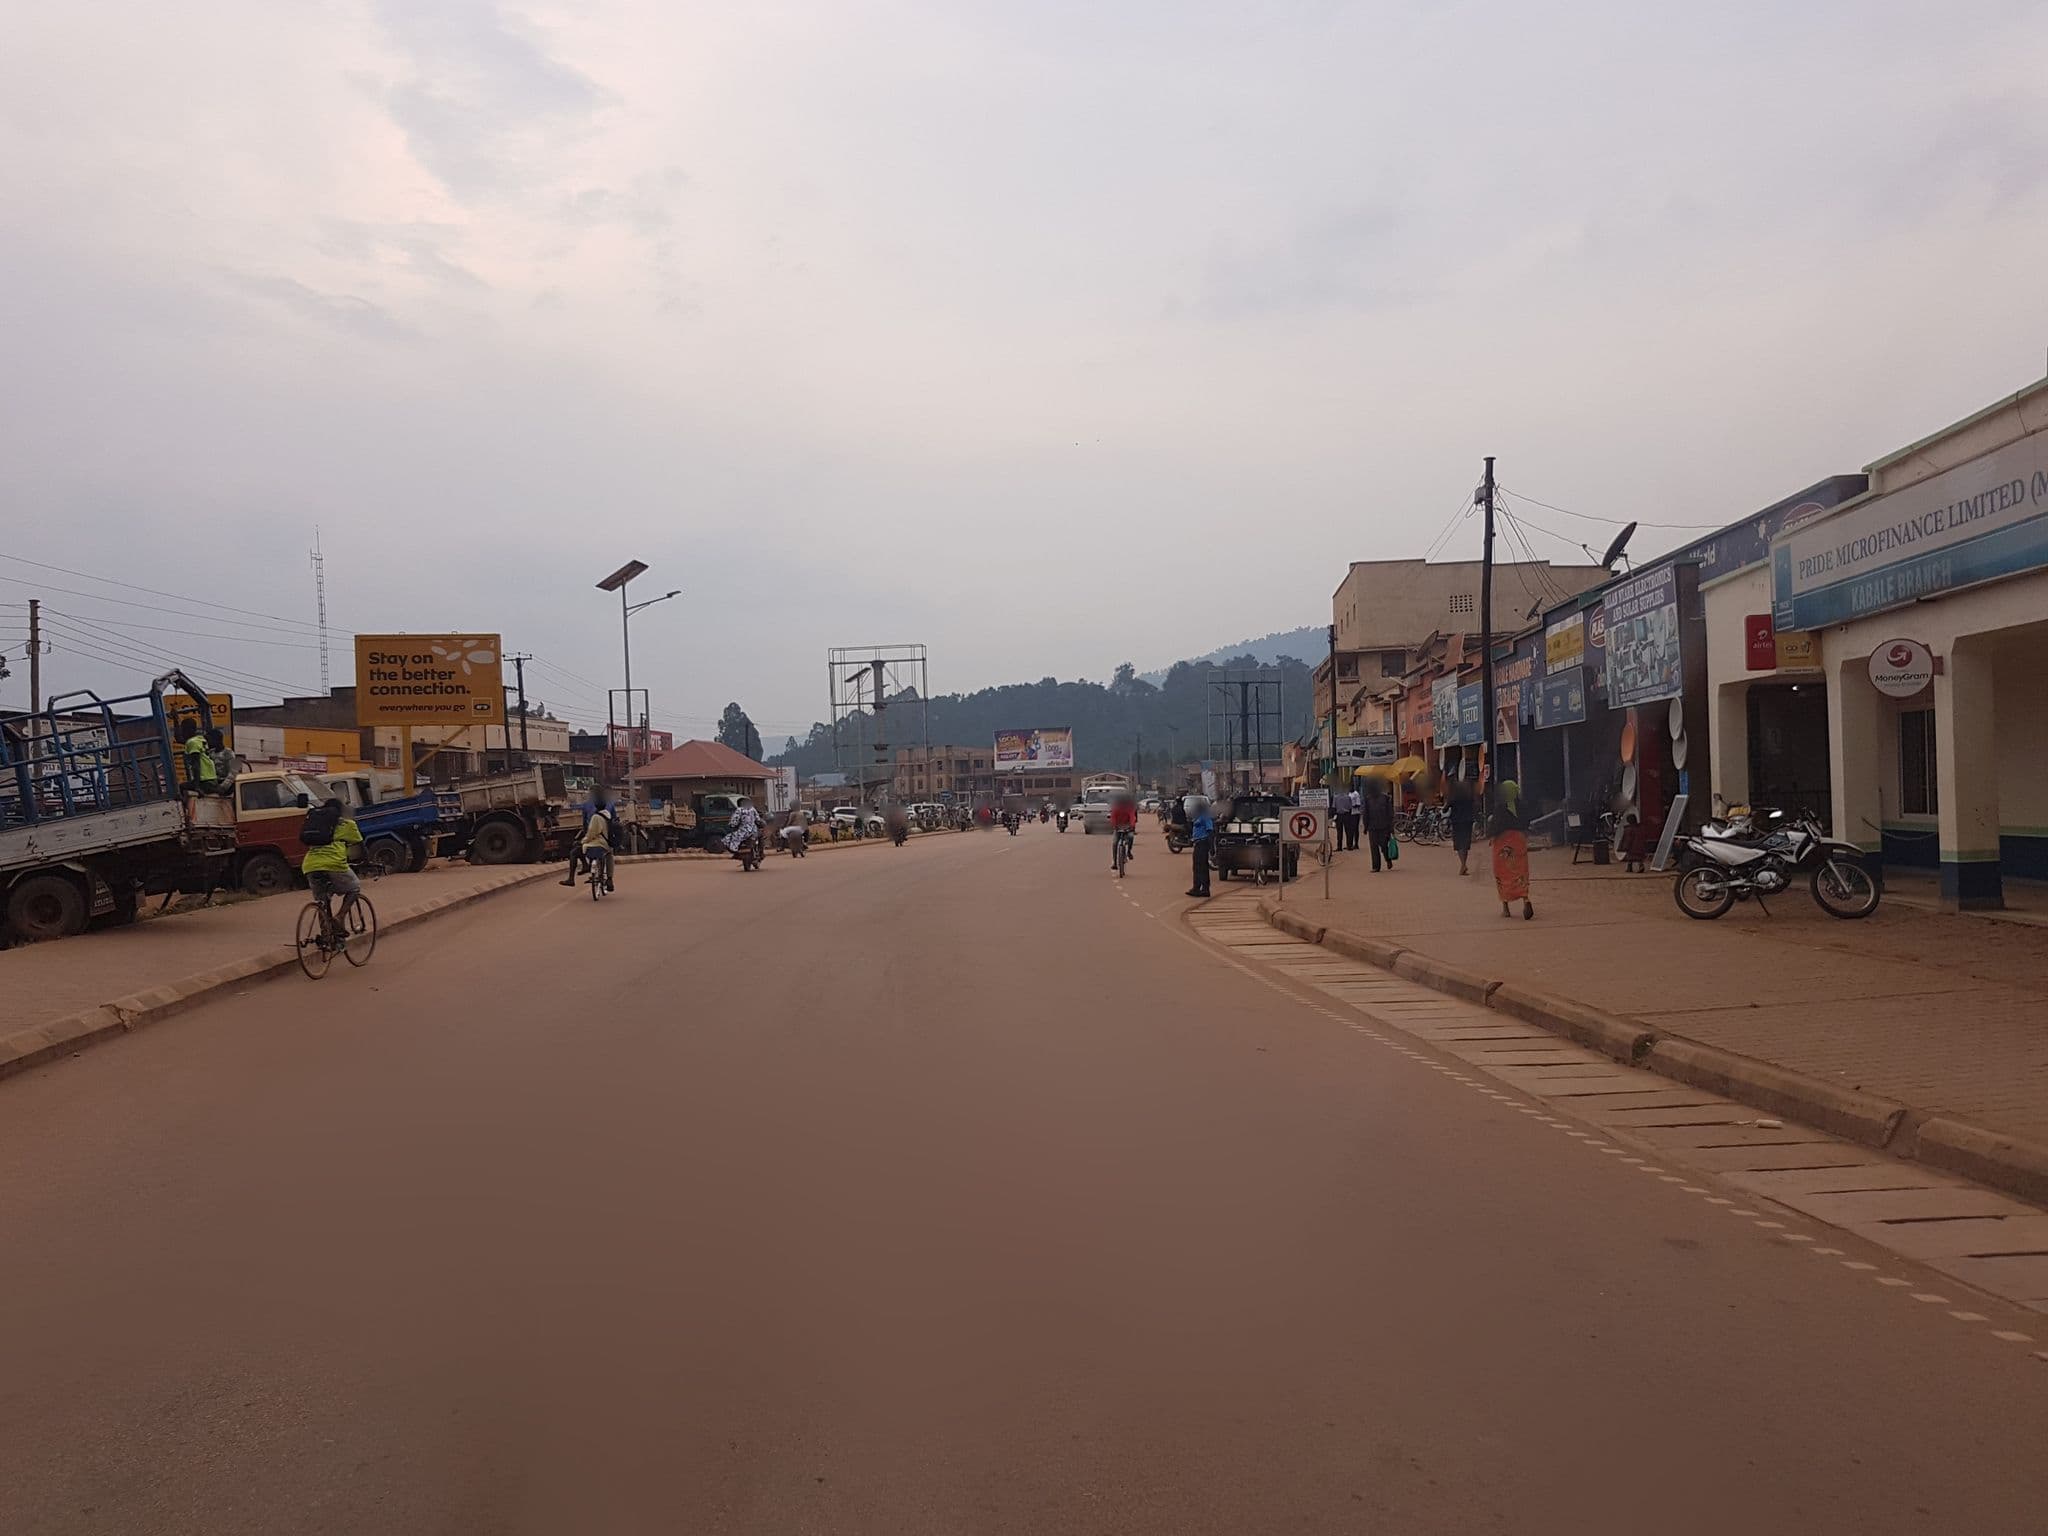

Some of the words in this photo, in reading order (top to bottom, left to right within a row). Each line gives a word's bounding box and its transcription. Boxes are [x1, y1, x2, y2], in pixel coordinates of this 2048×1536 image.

[1799, 551, 1833, 579] PRIDE
[1836, 509, 1944, 567] MICROFINANCE
[1948, 479, 2025, 528] LIMITED
[1852, 576, 1894, 611] KABALE
[1896, 559, 1951, 595] BRANCH
[1753, 641, 1773, 649] airtel
[369, 652, 407, 667] Stay
[412, 654, 433, 664] on
[369, 668, 397, 681] the
[402, 668, 456, 681] better
[1875, 673, 1929, 682] MoneyGram
[369, 682, 471, 695] connection.
[379, 703, 433, 712] everywhere
[434, 703, 452, 712] you
[453, 704, 466, 712] go
